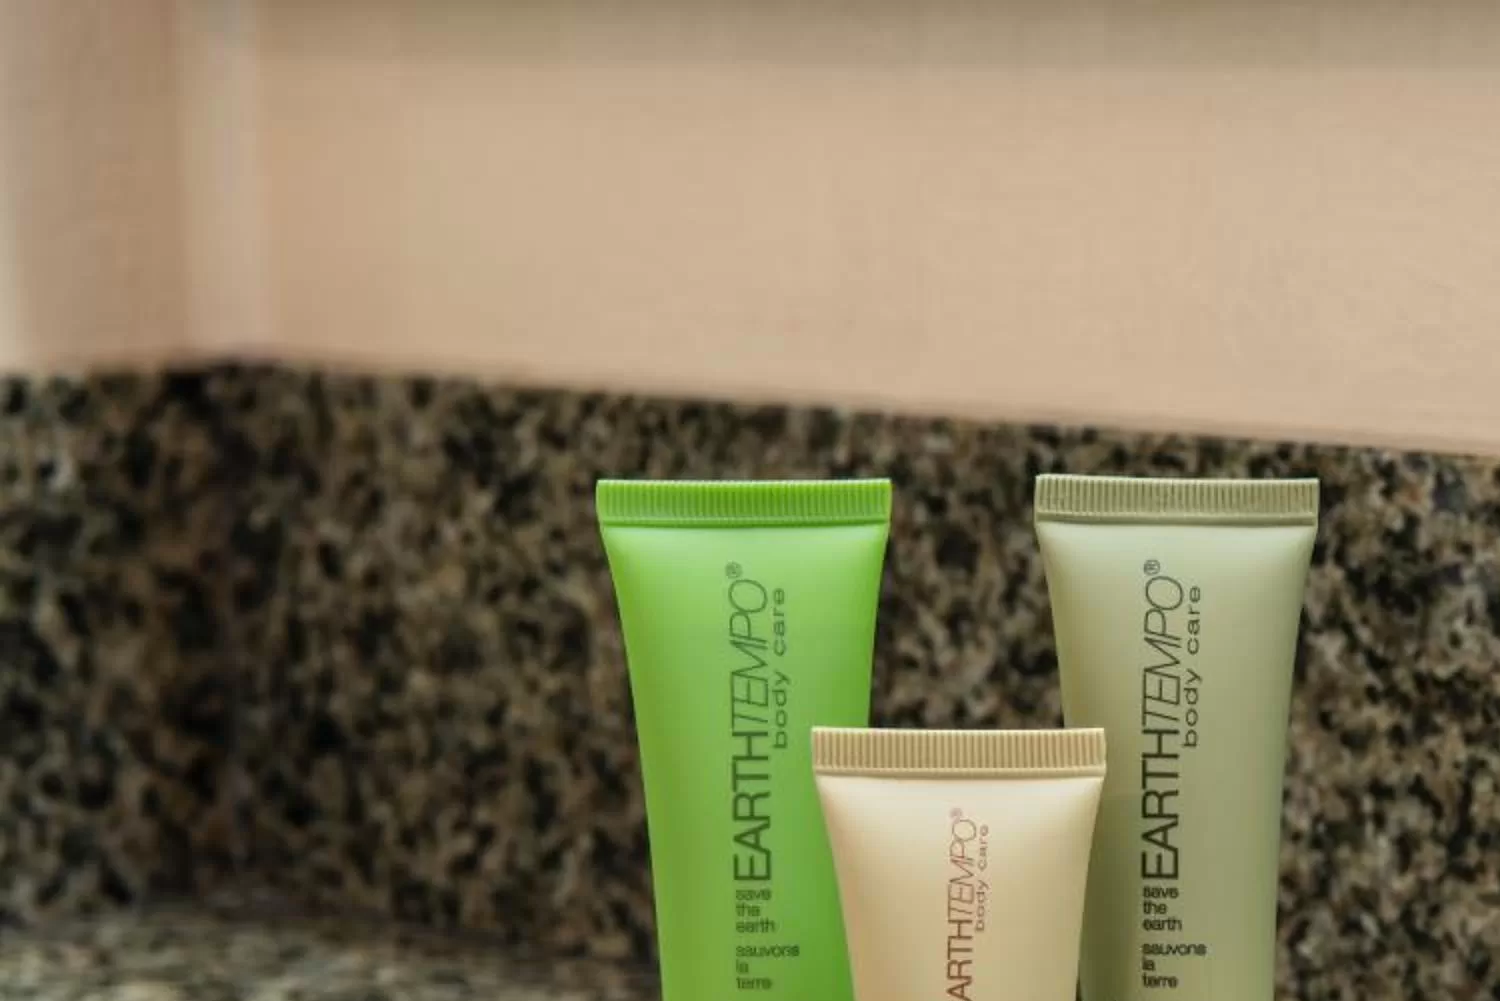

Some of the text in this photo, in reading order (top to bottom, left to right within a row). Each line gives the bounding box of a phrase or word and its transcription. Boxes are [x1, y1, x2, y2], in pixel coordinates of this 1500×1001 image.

[773, 588, 791, 749] body care
[1182, 586, 1202, 748] body care
[1142, 886, 1179, 898] save
[975, 880, 990, 932] body
[1142, 900, 1167, 914] the
[1142, 916, 1182, 931] earth
[1142, 974, 1178, 988] terre
